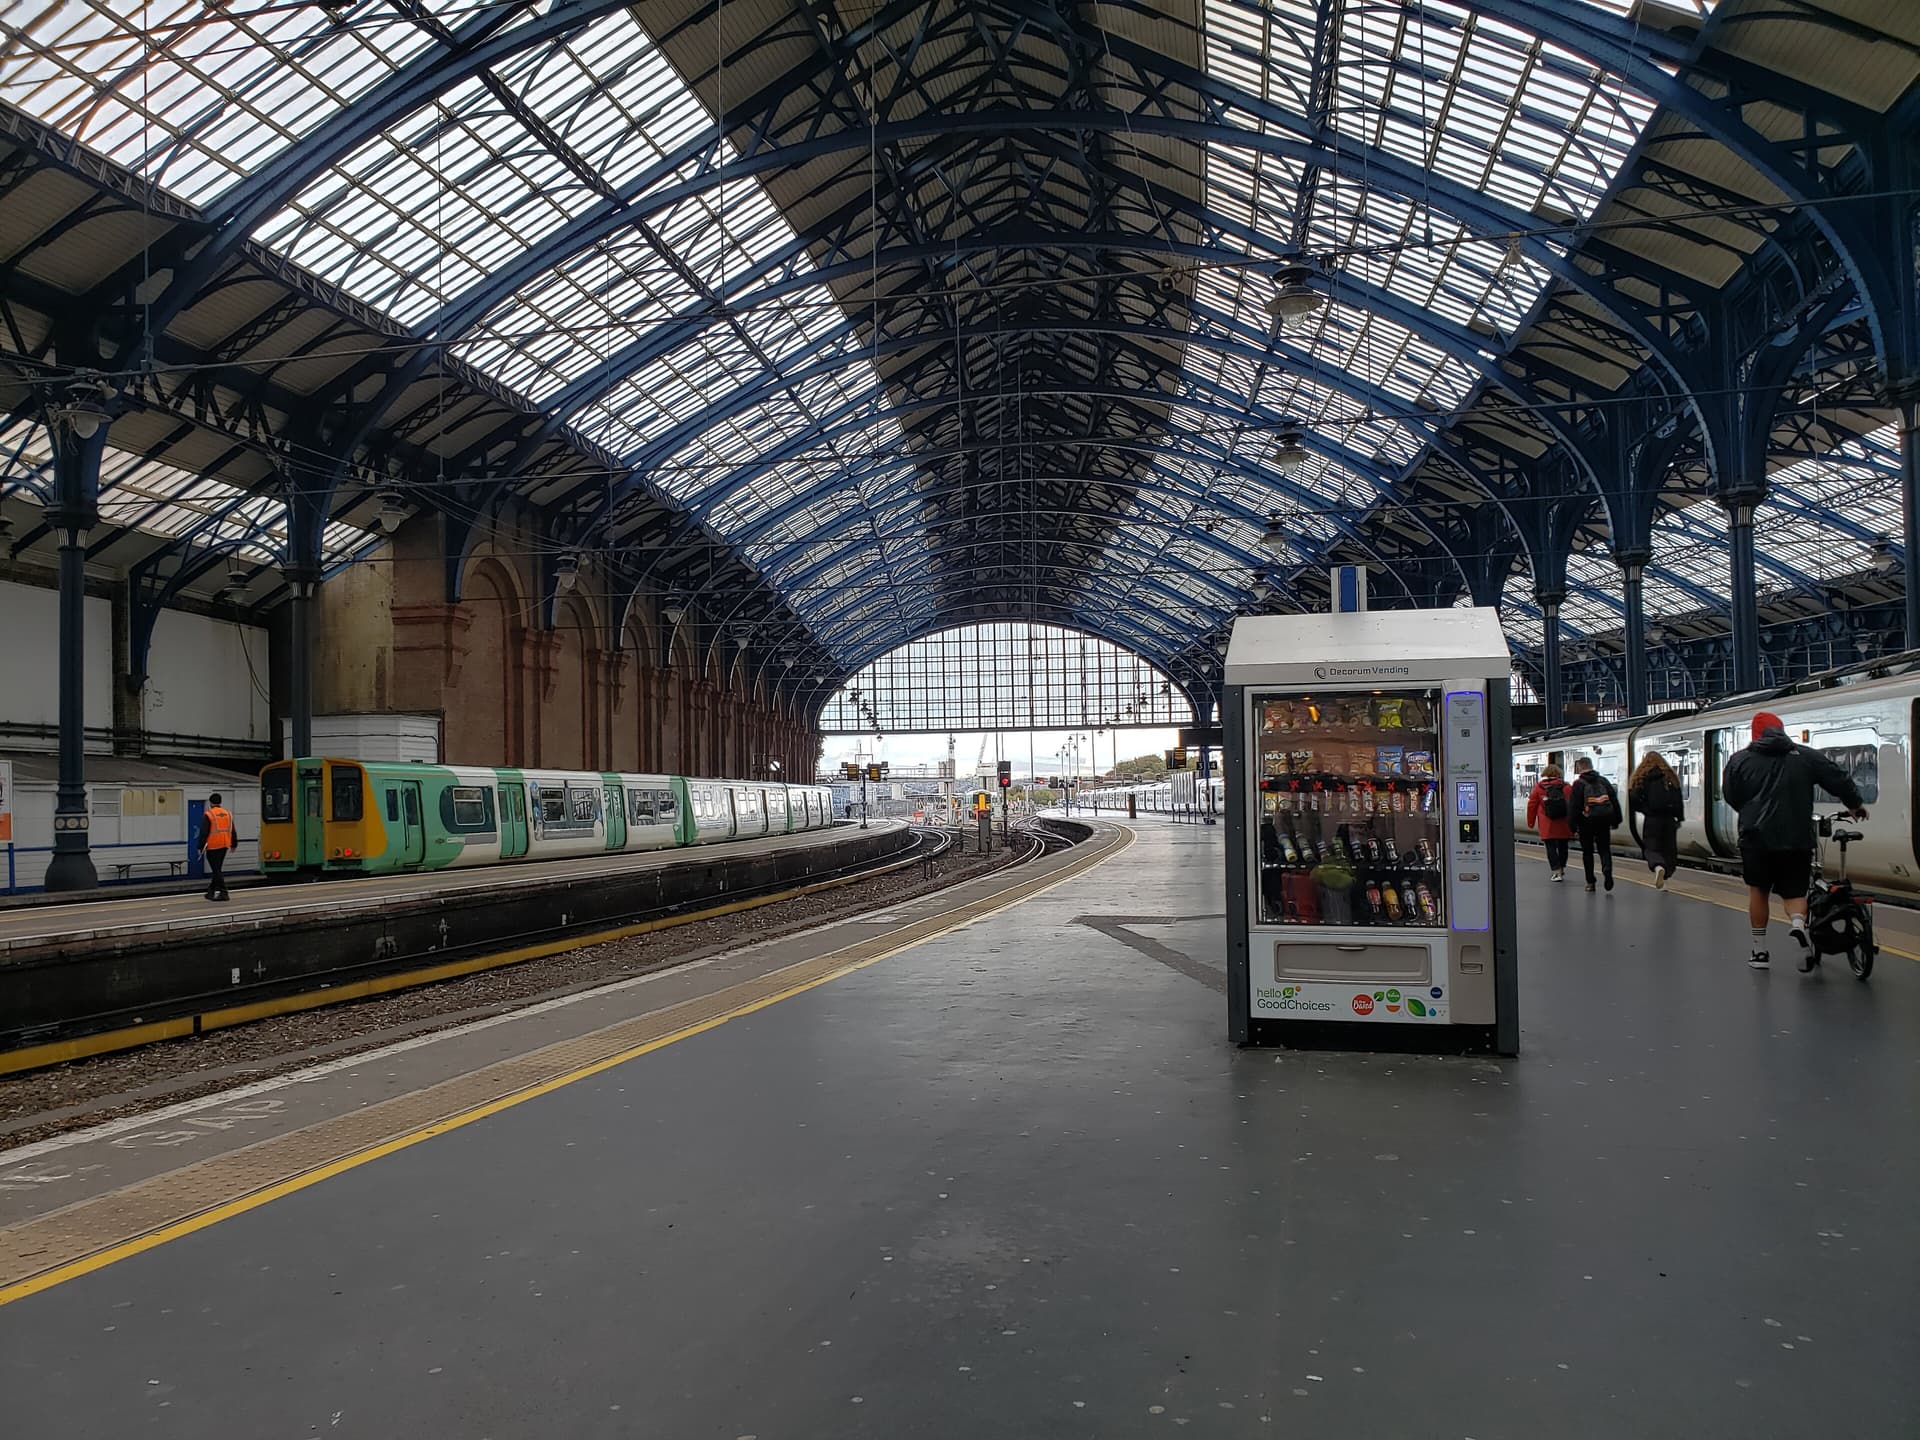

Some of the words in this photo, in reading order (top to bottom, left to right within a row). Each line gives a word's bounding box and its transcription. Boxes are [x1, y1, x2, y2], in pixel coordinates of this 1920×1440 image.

[1329, 668, 1371, 676] Decorum
[1372, 665, 1409, 675] Vending
[1264, 752, 1287, 761] MAX
[1256, 987, 1282, 998] hello
[1257, 998, 1331, 1011] GoodChoices
